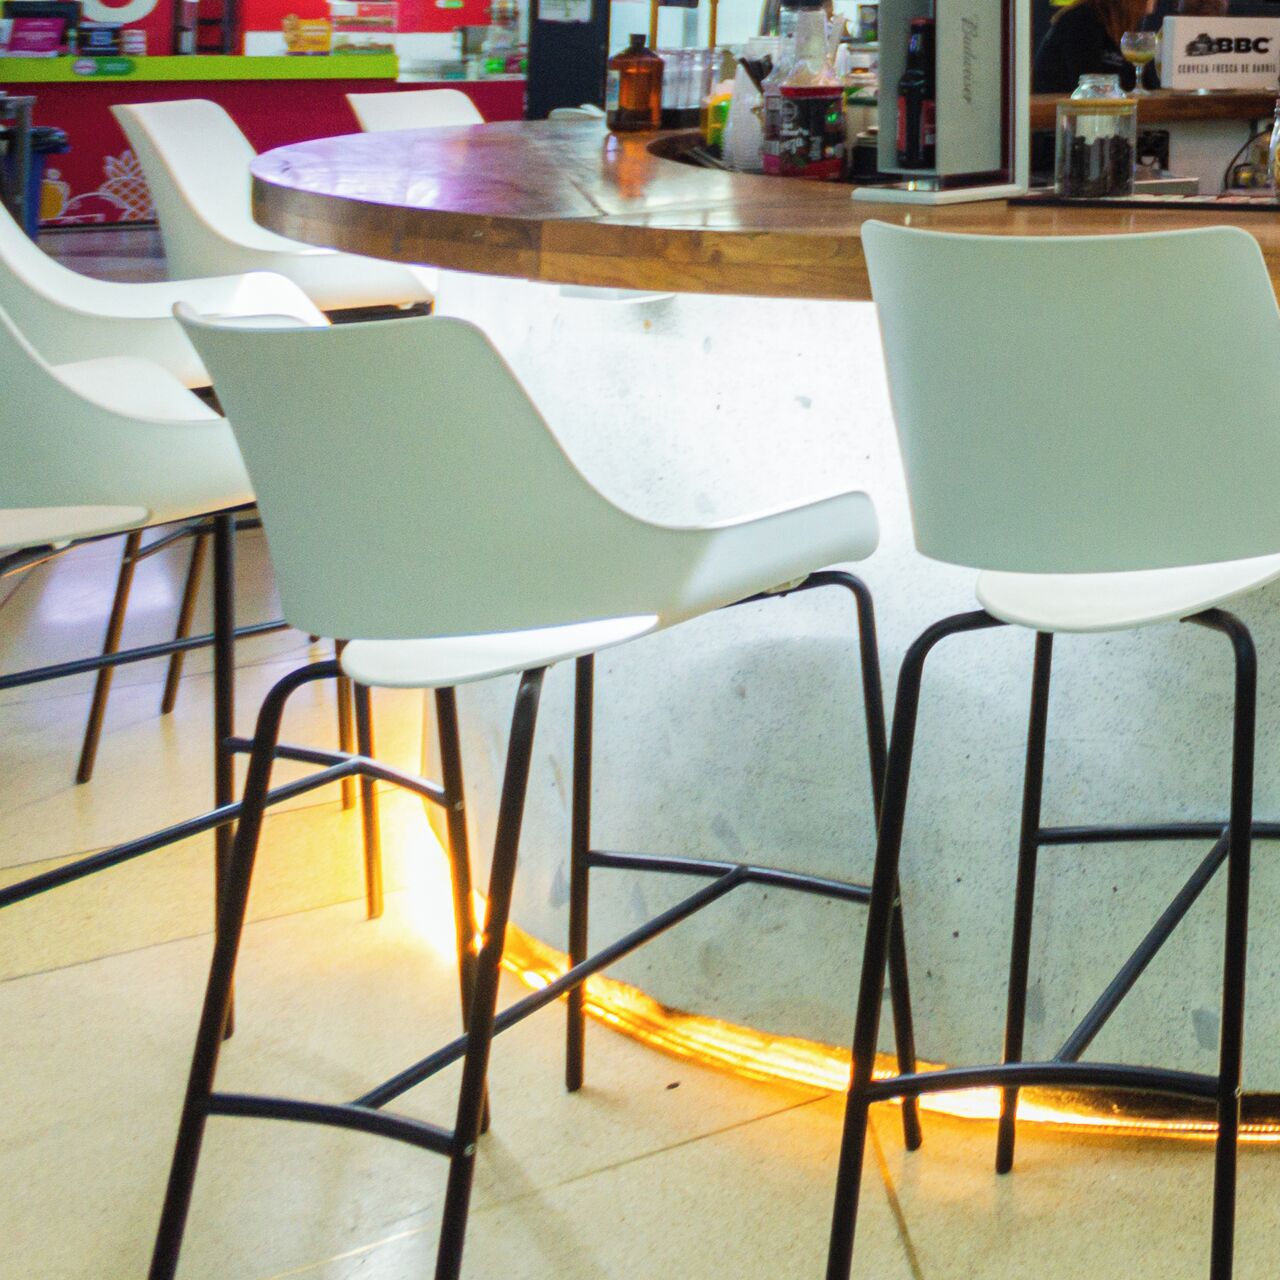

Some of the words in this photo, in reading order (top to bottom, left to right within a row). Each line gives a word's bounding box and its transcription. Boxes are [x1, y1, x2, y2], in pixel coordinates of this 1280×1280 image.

[1215, 36, 1271, 54] BBC
[1178, 63, 1209, 74] CERVEZA
[1211, 63, 1238, 74] FRESCA
[1241, 63, 1249, 73] DE
